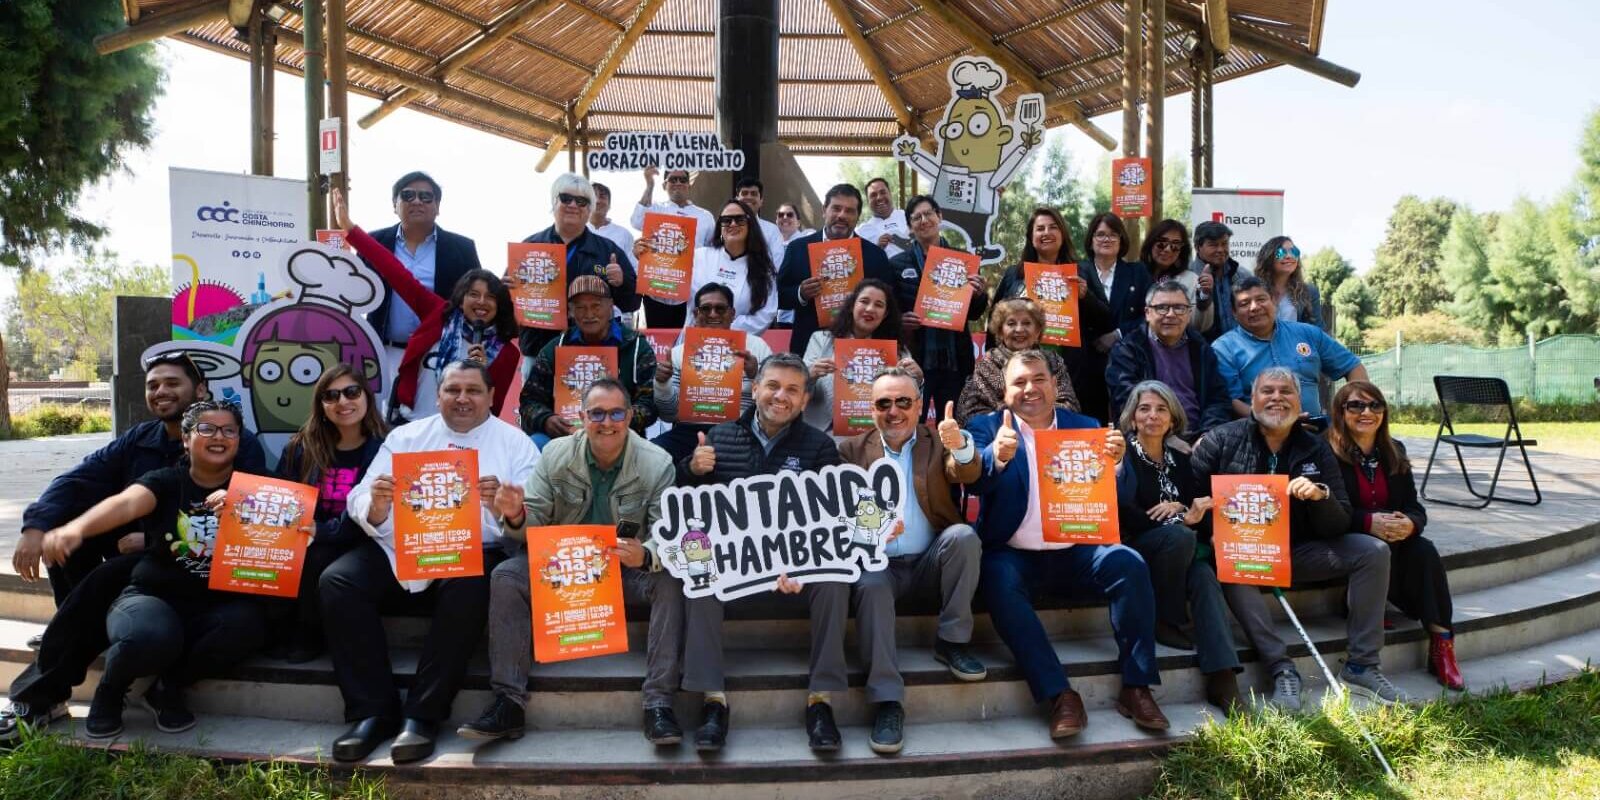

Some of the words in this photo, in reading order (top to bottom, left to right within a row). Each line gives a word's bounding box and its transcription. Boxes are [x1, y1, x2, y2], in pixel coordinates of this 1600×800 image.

[608, 134, 670, 151] GUATITA
[589, 148, 660, 170] CORAZÓN
[665, 152, 742, 169] CONTENTO
[242, 212, 268, 221] COSTA
[242, 219, 295, 229] CHINCHORRO
[854, 374, 874, 384] va
[1059, 449, 1094, 461] car
[420, 471, 459, 484] car
[255, 490, 296, 504] car
[658, 463, 900, 541] JUNTANDO
[1236, 491, 1270, 503] car
[557, 544, 597, 558] car
[715, 526, 852, 576] HAMBRE
[559, 569, 593, 586] val
